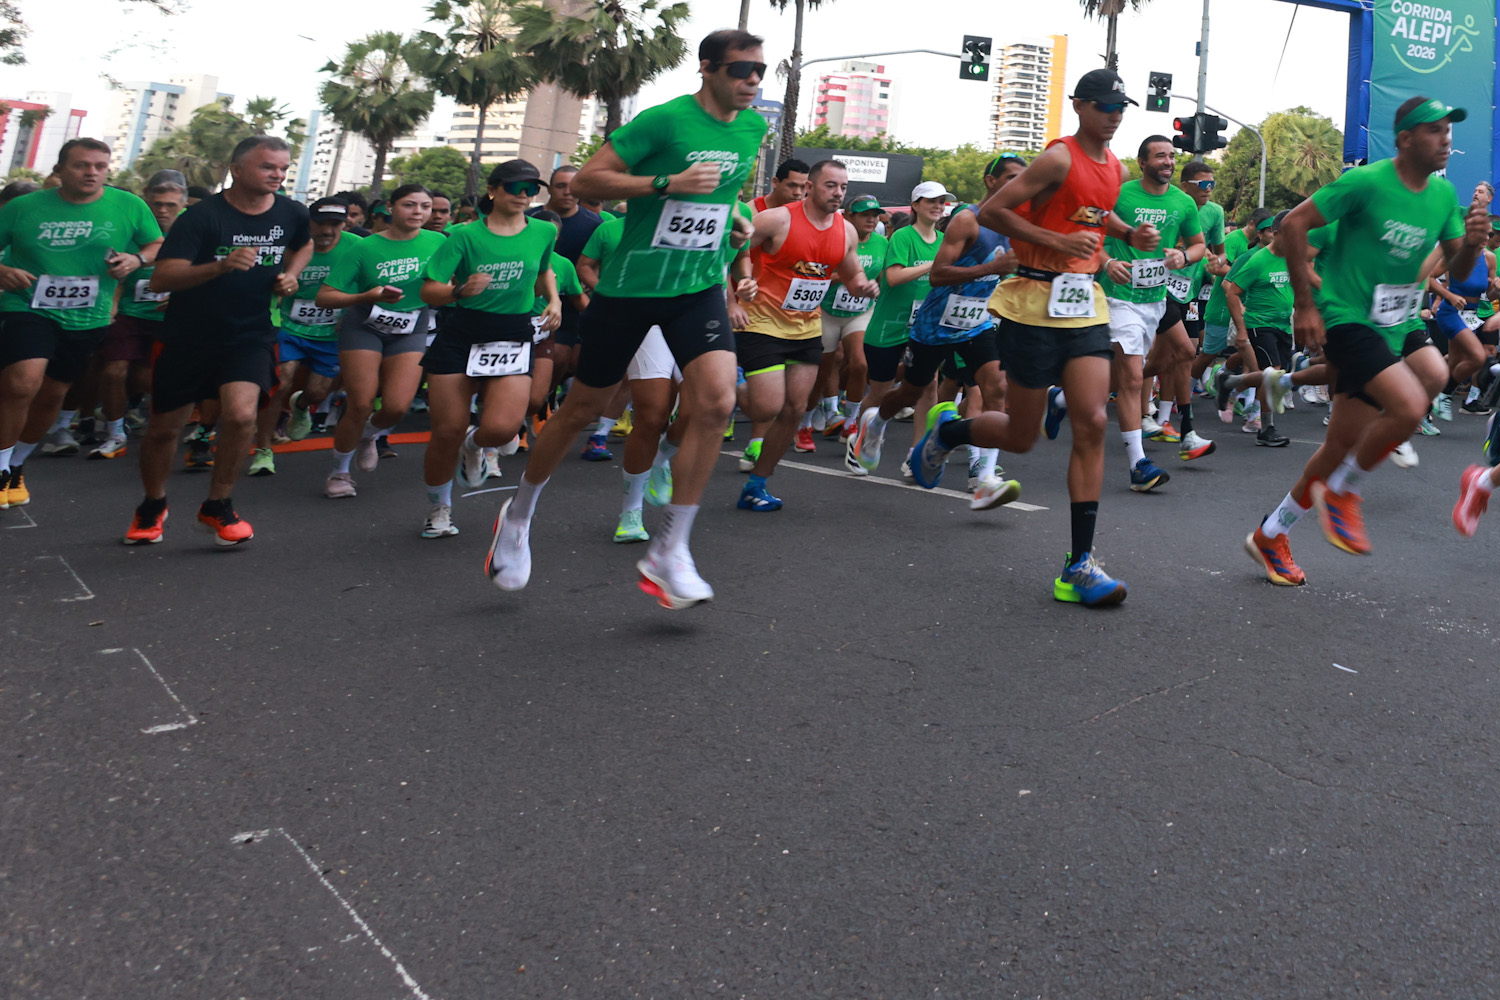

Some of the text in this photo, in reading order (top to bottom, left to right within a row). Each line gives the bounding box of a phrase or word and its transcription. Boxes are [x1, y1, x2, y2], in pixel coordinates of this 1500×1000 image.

[1391, 0, 1452, 24] CORRIDA
[1391, 16, 1452, 46] ALEPI
[1407, 44, 1436, 60] 2026
[685, 150, 739, 161] CORRIDA
[1135, 207, 1166, 215] CORRIDA
[39, 220, 93, 229] CORRIDA
[1134, 213, 1166, 224] ALEPI
[669, 216, 717, 235] 5246
[37, 227, 92, 239] ALEPI
[233, 234, 274, 243] FÓRMULA
[376, 257, 419, 270] CORRIDA
[476, 261, 524, 272] CORRIDA
[377, 262, 419, 279] ALEPI
[490, 269, 523, 282] LEPI
[1138, 265, 1165, 279] 1270
[389, 273, 410, 283] 2026
[1167, 277, 1188, 293] 5433
[45, 286, 90, 298] 6123
[793, 290, 823, 302] 5303
[1058, 287, 1090, 303] 1294
[298, 307, 334, 317] 5279
[951, 306, 984, 320] 1147
[374, 314, 410, 329] 5268
[479, 353, 519, 366] 5747
